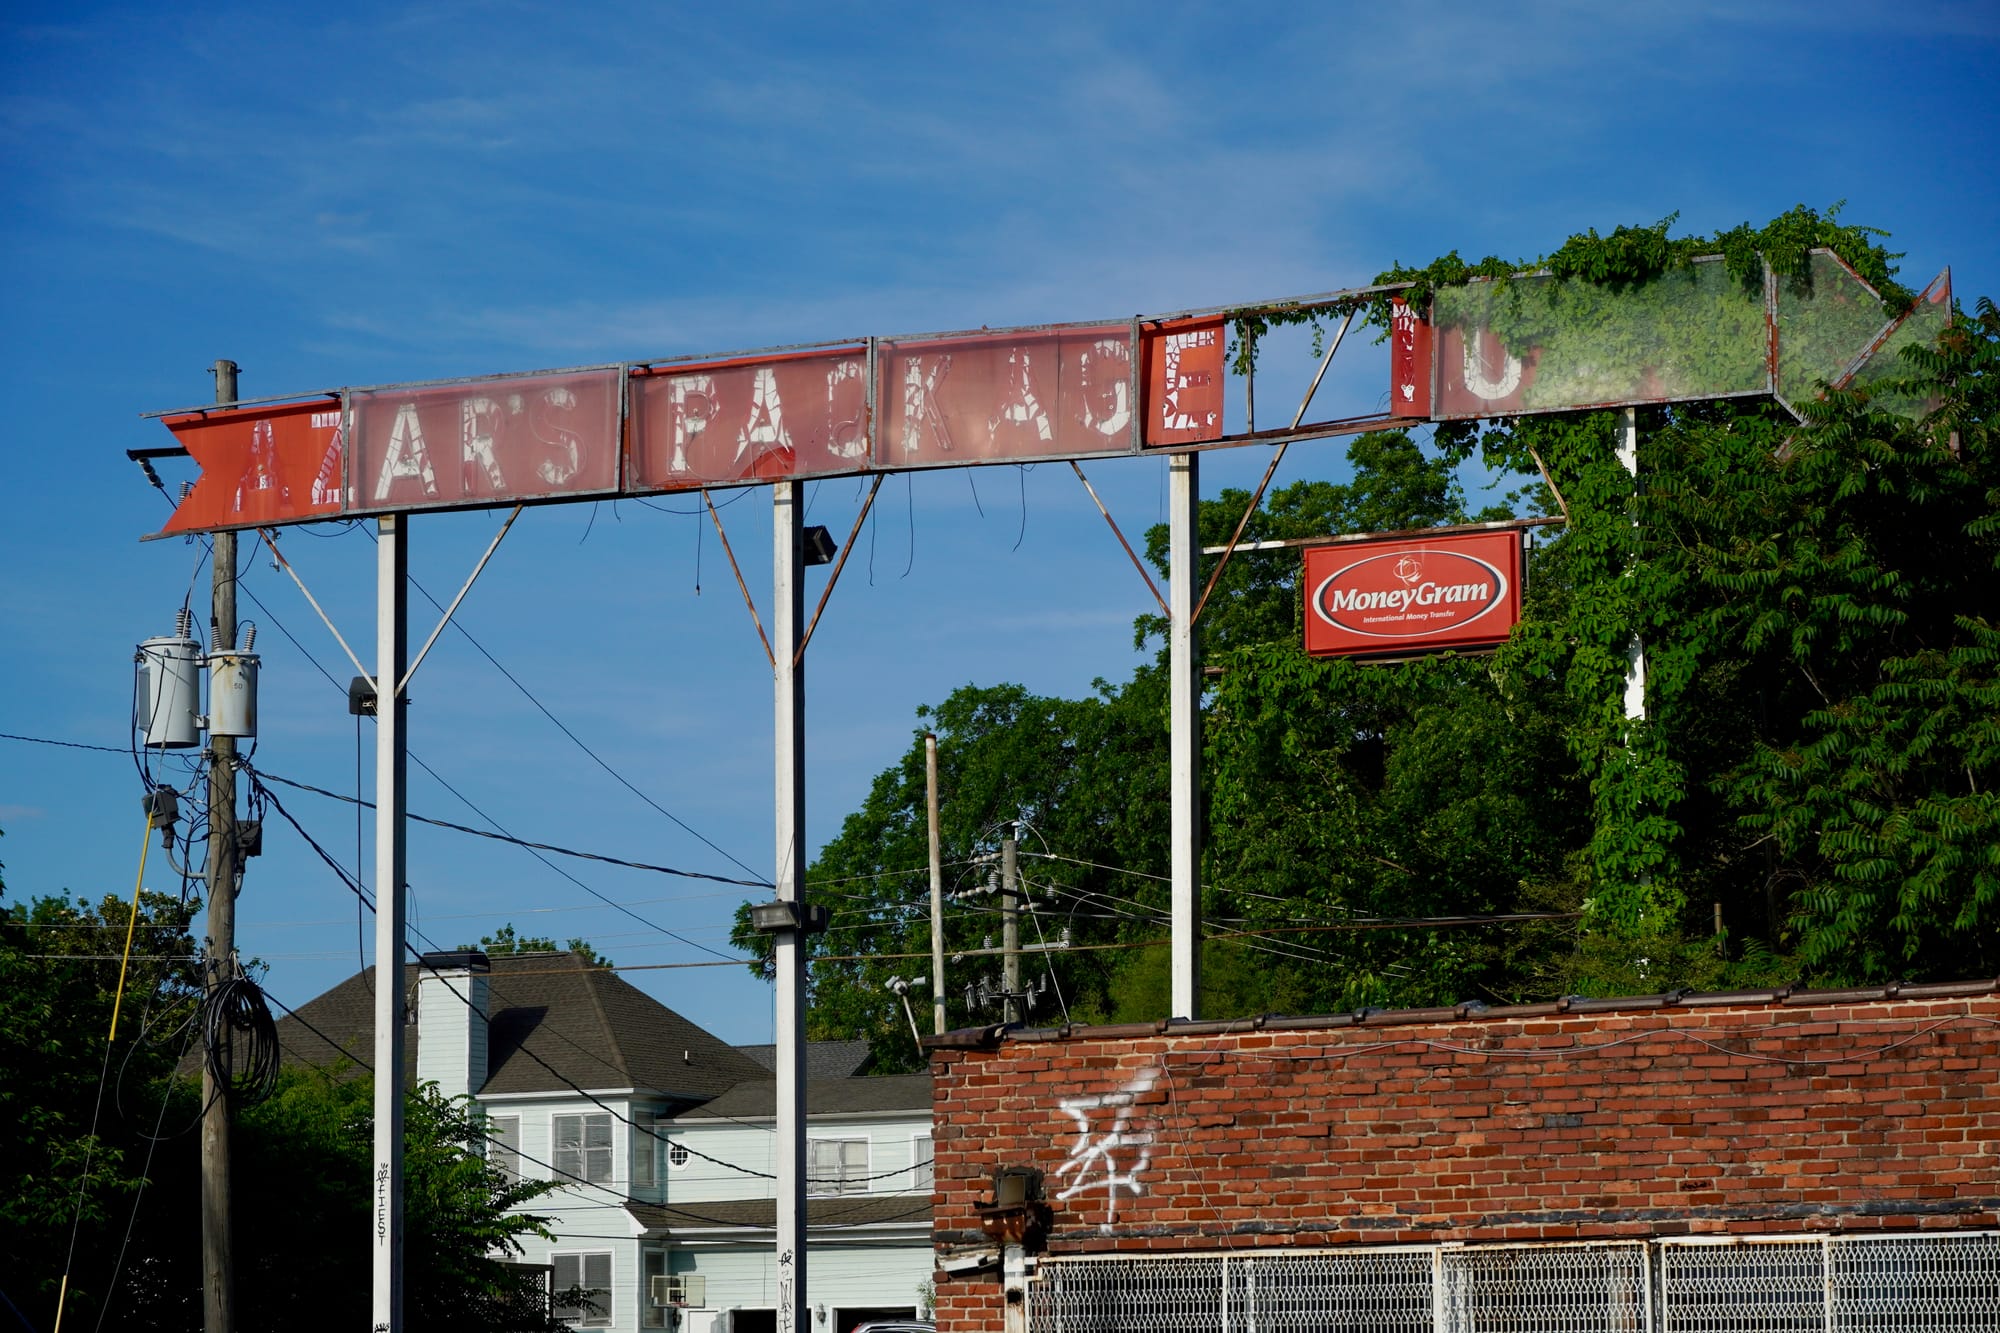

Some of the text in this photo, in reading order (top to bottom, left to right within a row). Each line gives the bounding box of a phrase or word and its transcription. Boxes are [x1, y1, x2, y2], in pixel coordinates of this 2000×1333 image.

[668, 330, 1217, 475] PACKAGE
[1331, 582, 1488, 612] MoneyGram
[1363, 610, 1456, 624] International Money Transfer
